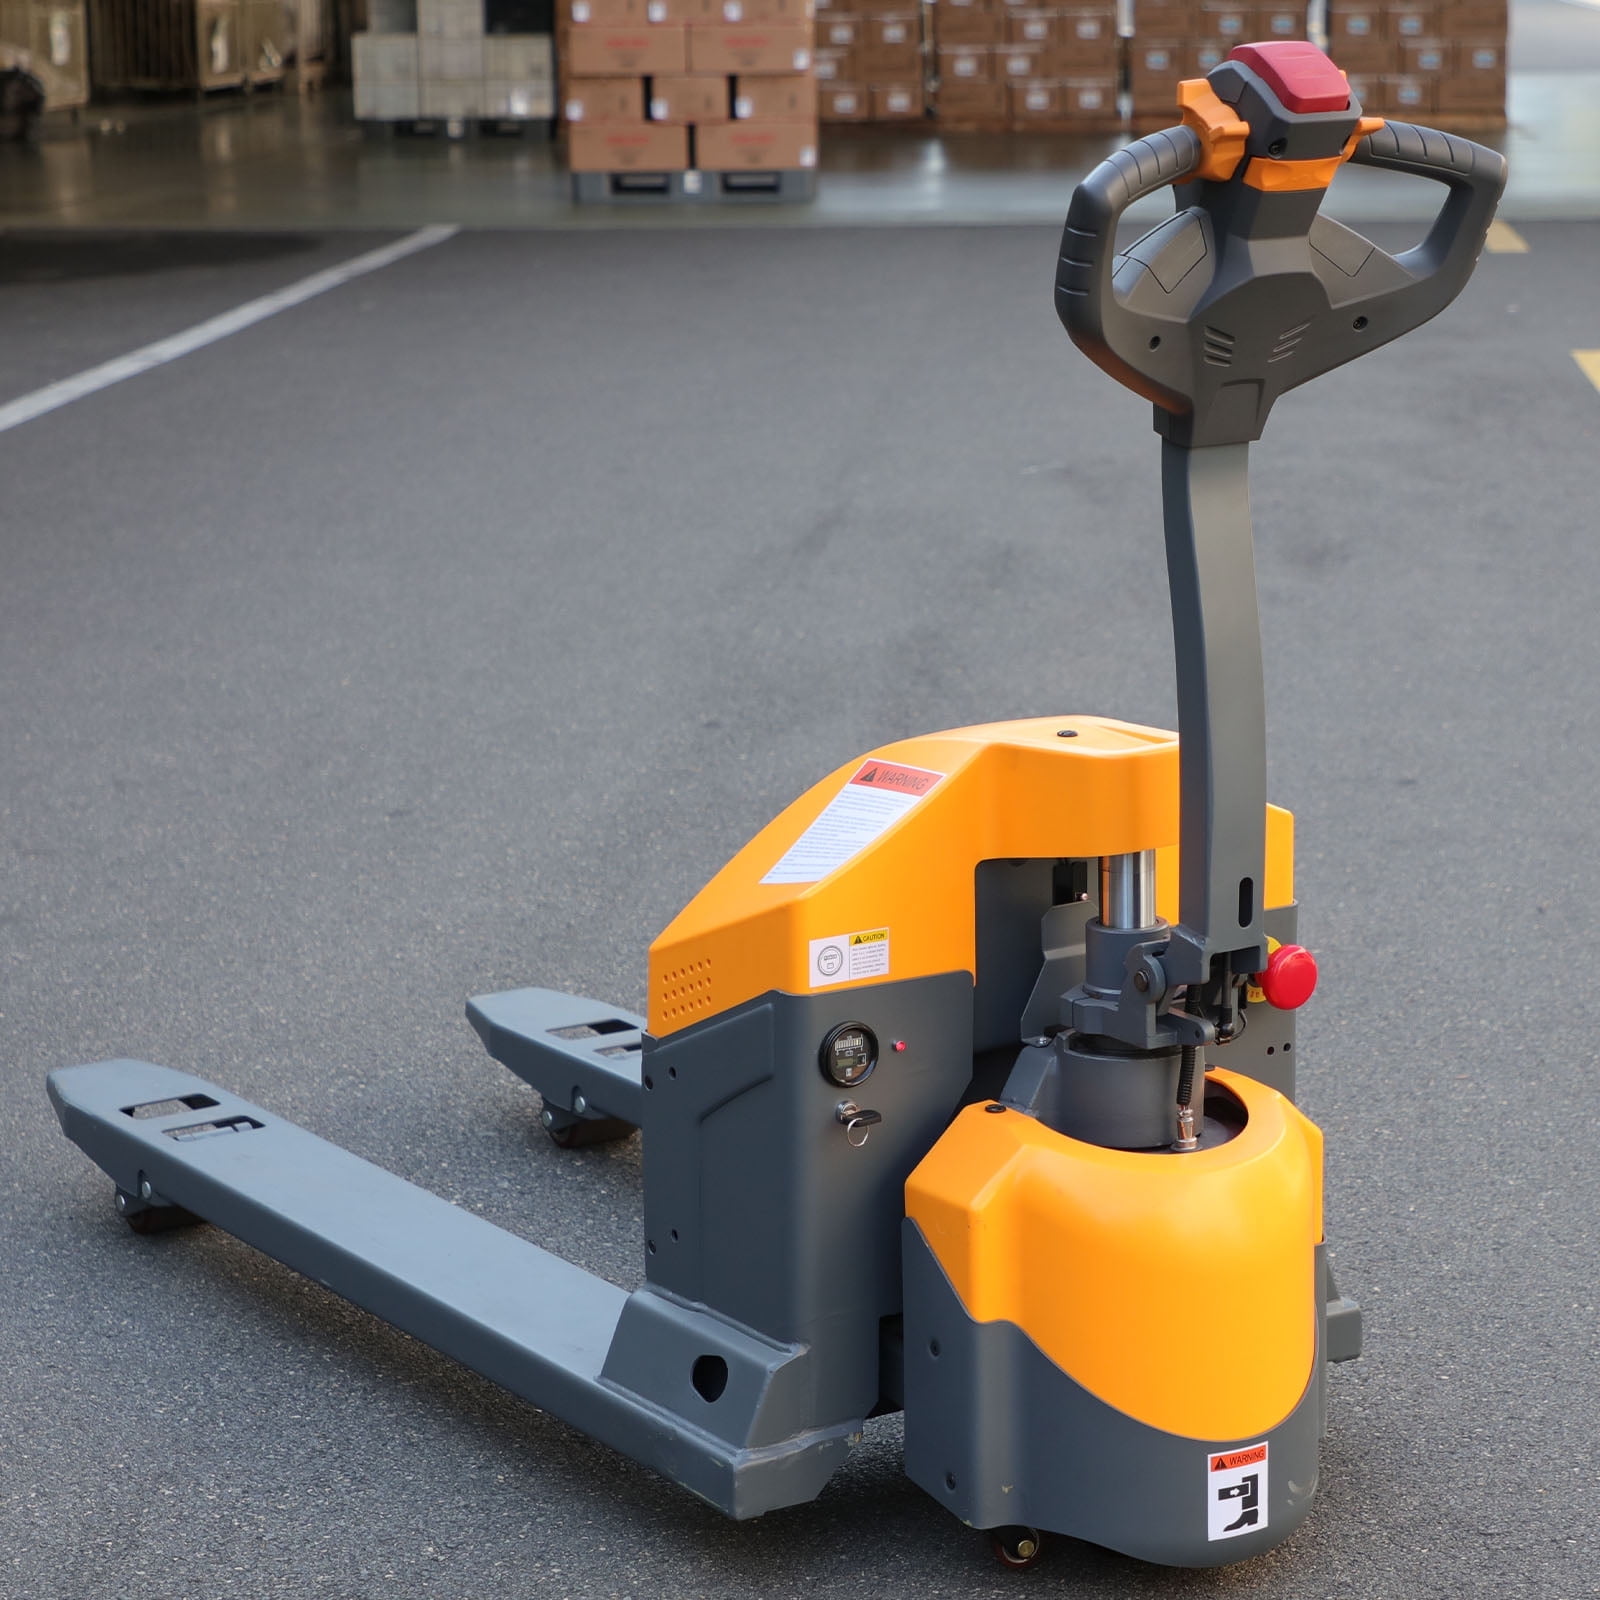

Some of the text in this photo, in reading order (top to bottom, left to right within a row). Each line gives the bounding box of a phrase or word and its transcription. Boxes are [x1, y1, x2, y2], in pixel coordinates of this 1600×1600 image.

[878, 769, 929, 790] WARNING
[862, 933, 885, 942] CAUTION
[1230, 1449, 1264, 1466] WARNING
